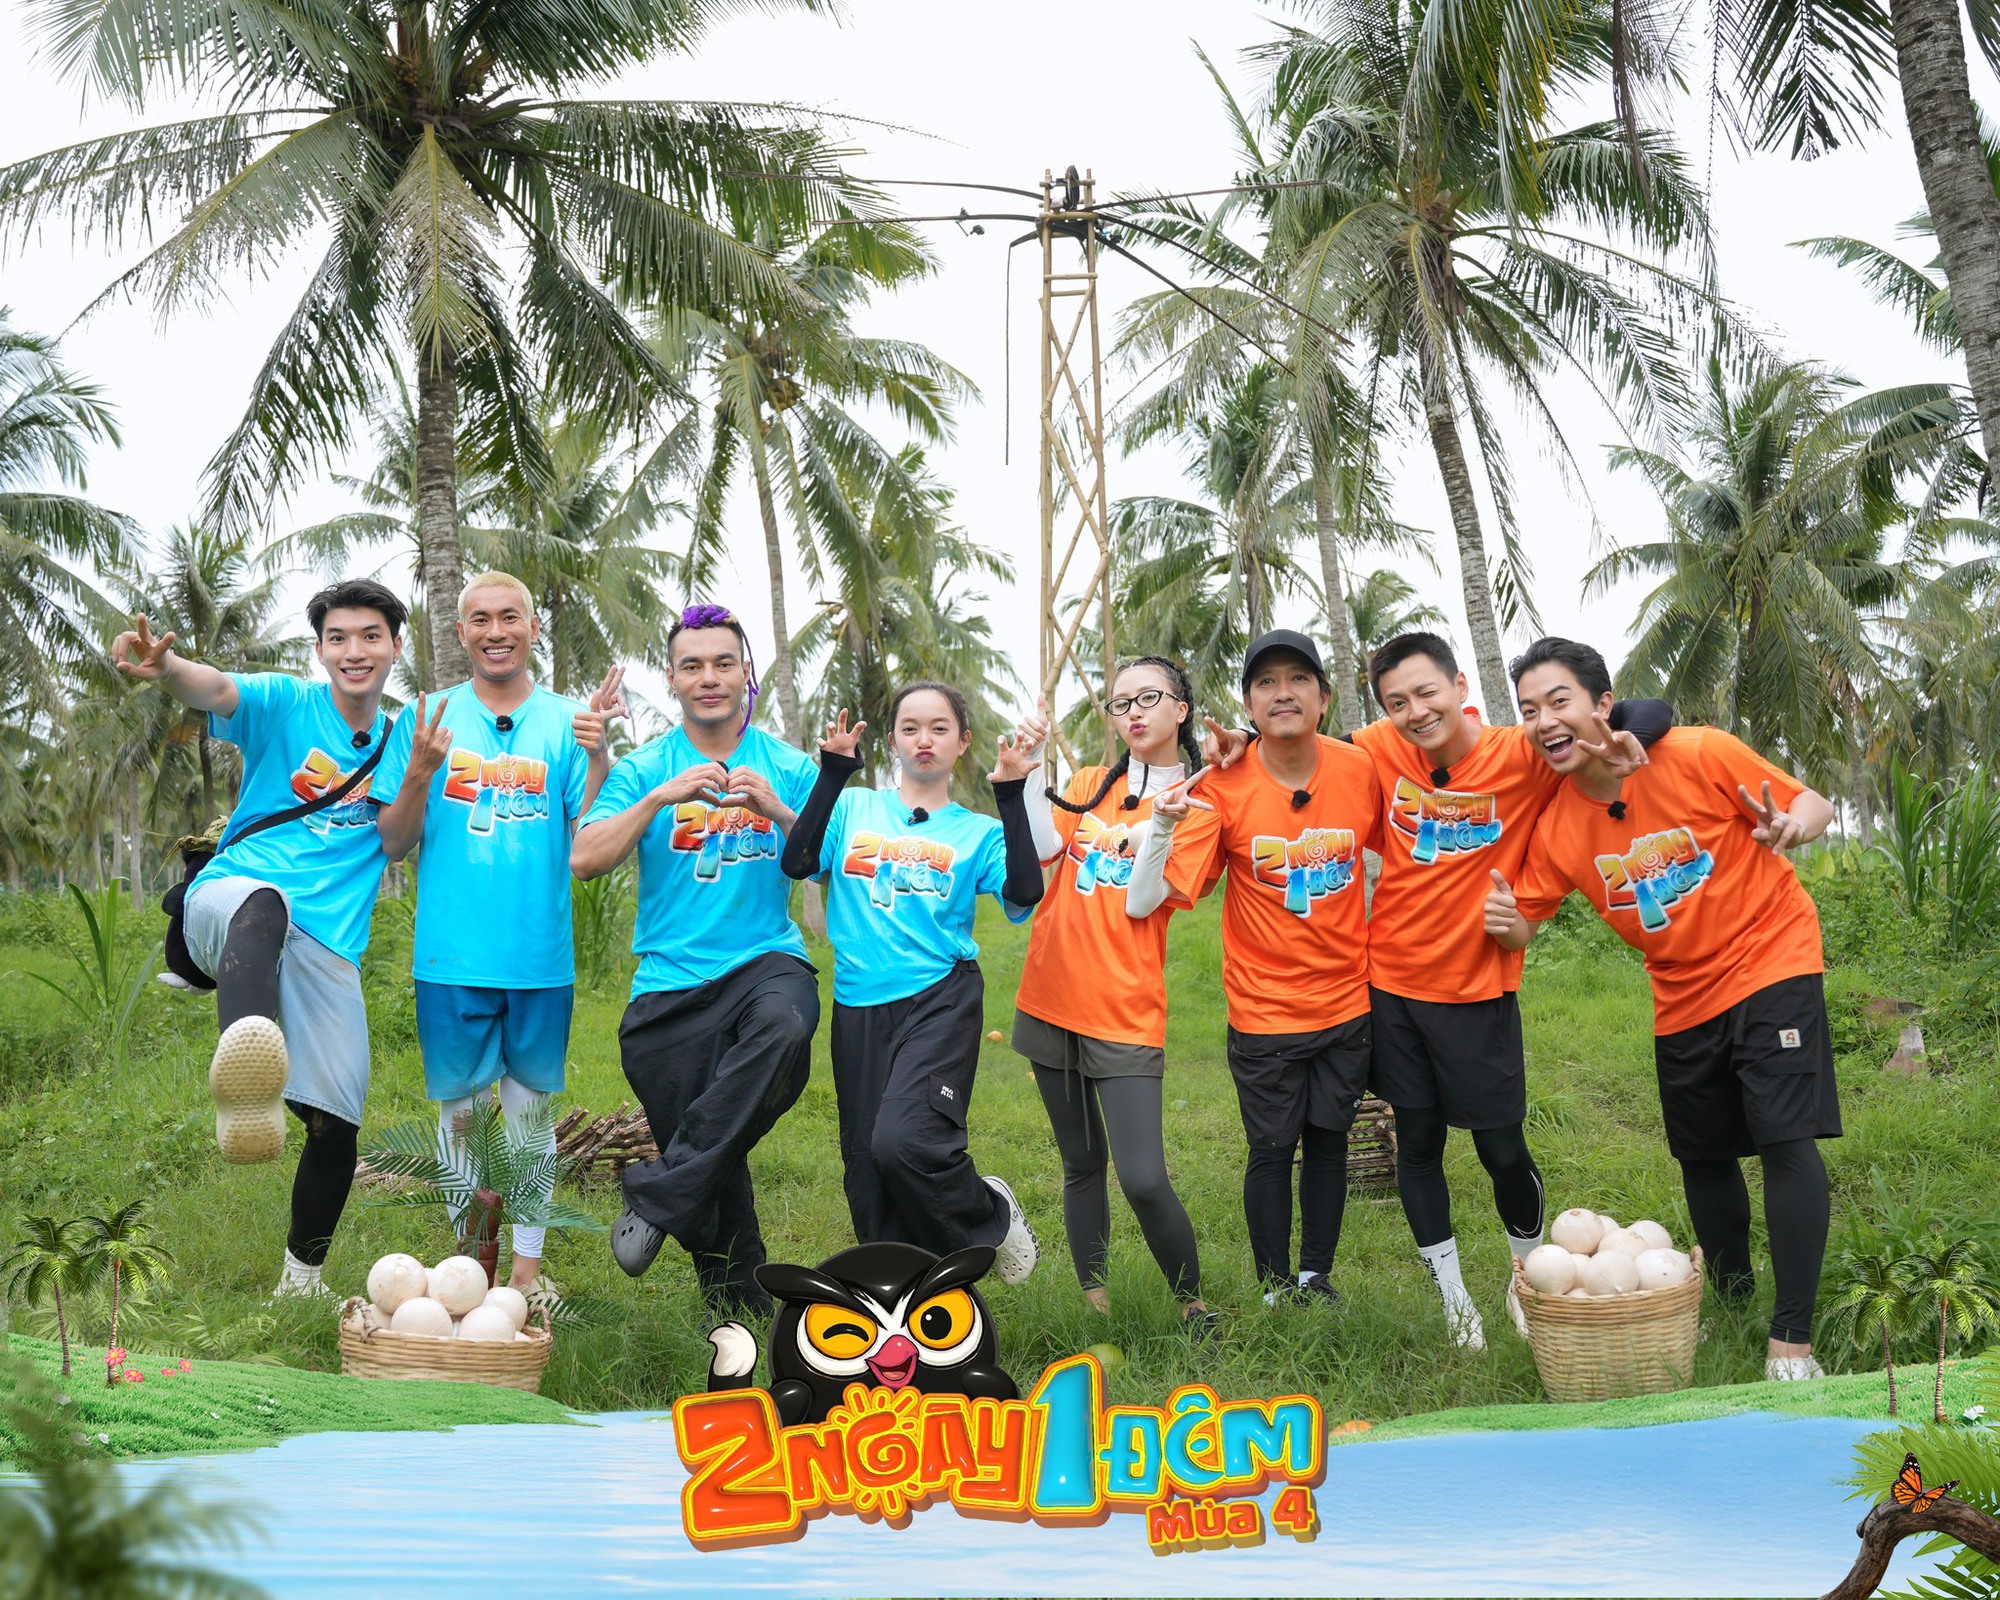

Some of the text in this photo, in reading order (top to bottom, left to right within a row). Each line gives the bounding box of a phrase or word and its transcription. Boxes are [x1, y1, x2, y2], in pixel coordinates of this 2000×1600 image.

[292, 751, 338, 802] 2
[444, 751, 482, 803] 2
[471, 786, 548, 832] 1 ĐÊM
[673, 803, 707, 851] 2
[1392, 779, 1421, 835] 2
[697, 827, 776, 878] 1 ĐÊM
[845, 832, 883, 879] 2
[1068, 815, 1102, 863] 2
[1255, 838, 1288, 888] 2
[1413, 819, 1502, 863] 1 ĐÊM
[872, 862, 953, 908] 1 ĐÊM
[1077, 851, 1102, 892] 1
[1286, 867, 1308, 914] 1
[1598, 856, 1637, 908] 2
[1634, 851, 1715, 929] 1 ĐÊM
